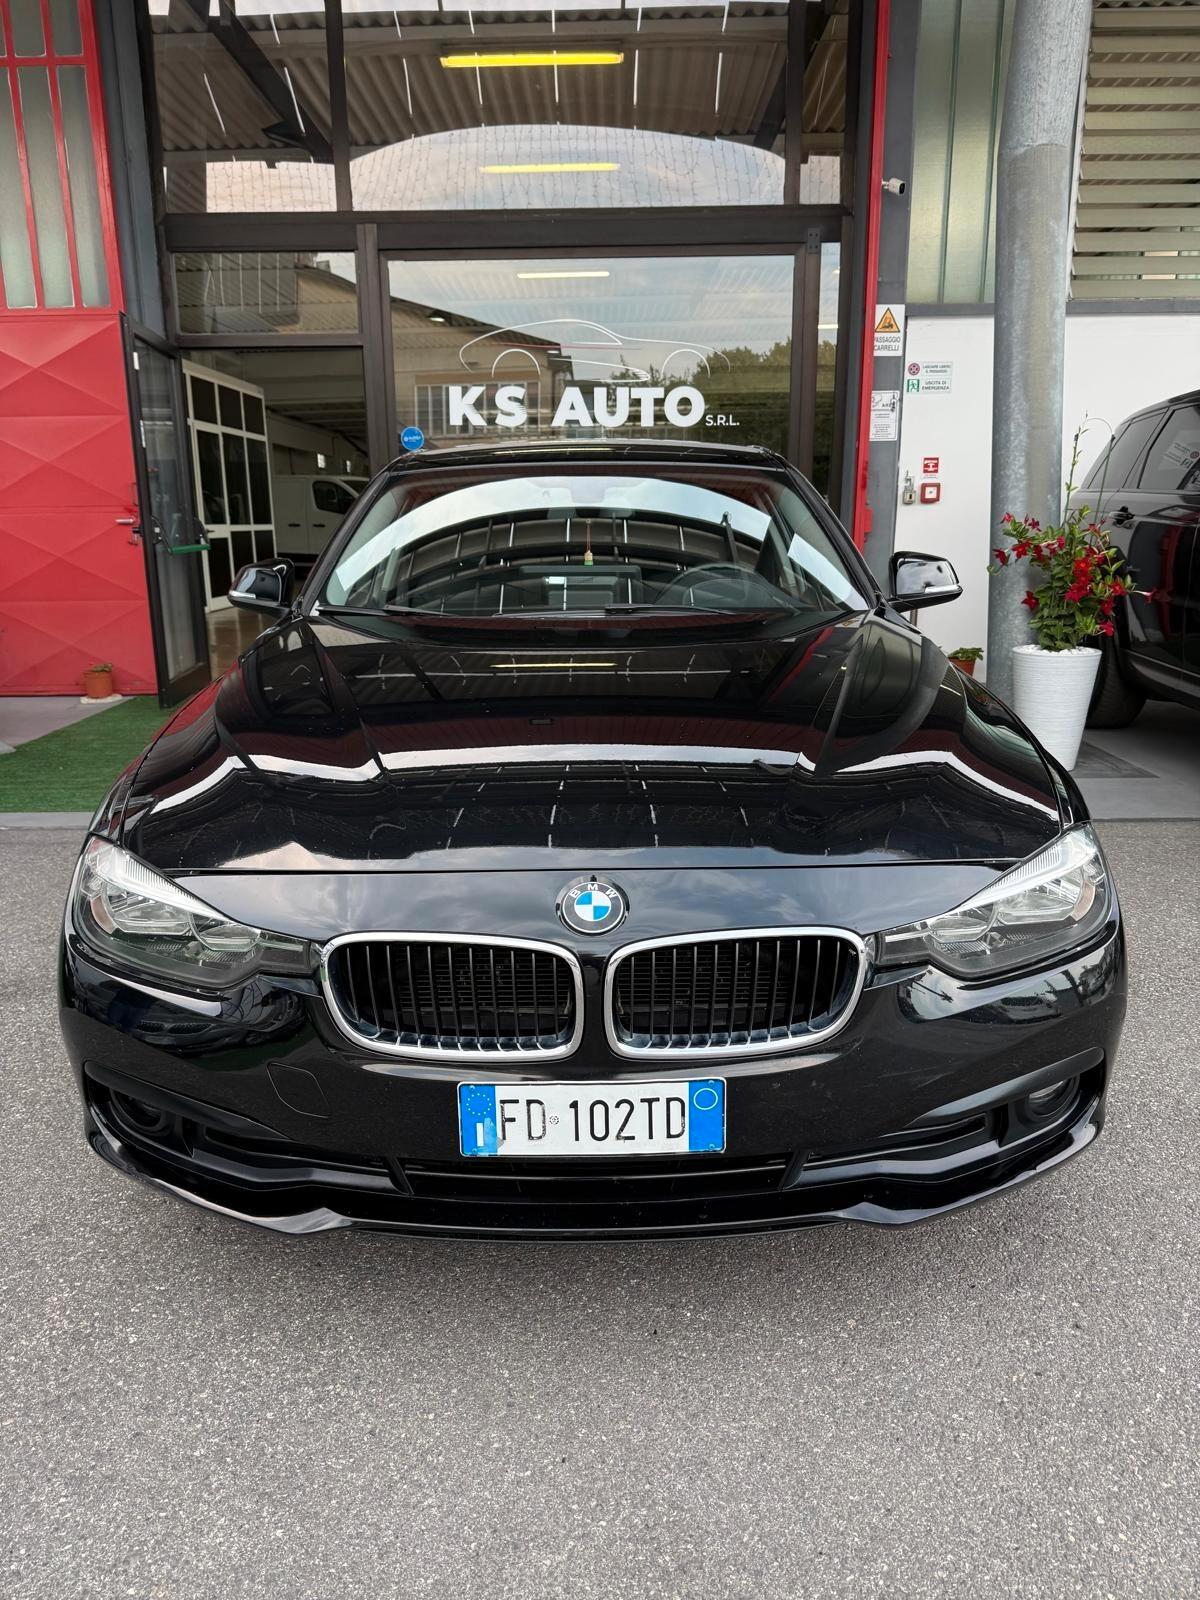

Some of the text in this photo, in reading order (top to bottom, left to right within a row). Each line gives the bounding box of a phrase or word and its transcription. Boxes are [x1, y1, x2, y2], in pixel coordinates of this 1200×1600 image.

[874, 344, 900, 352] CARRELLI
[449, 385, 740, 428] KS AUTO S.R.L.
[569, 883, 618, 899] BMW
[499, 1096, 686, 1142] FD 102TD
